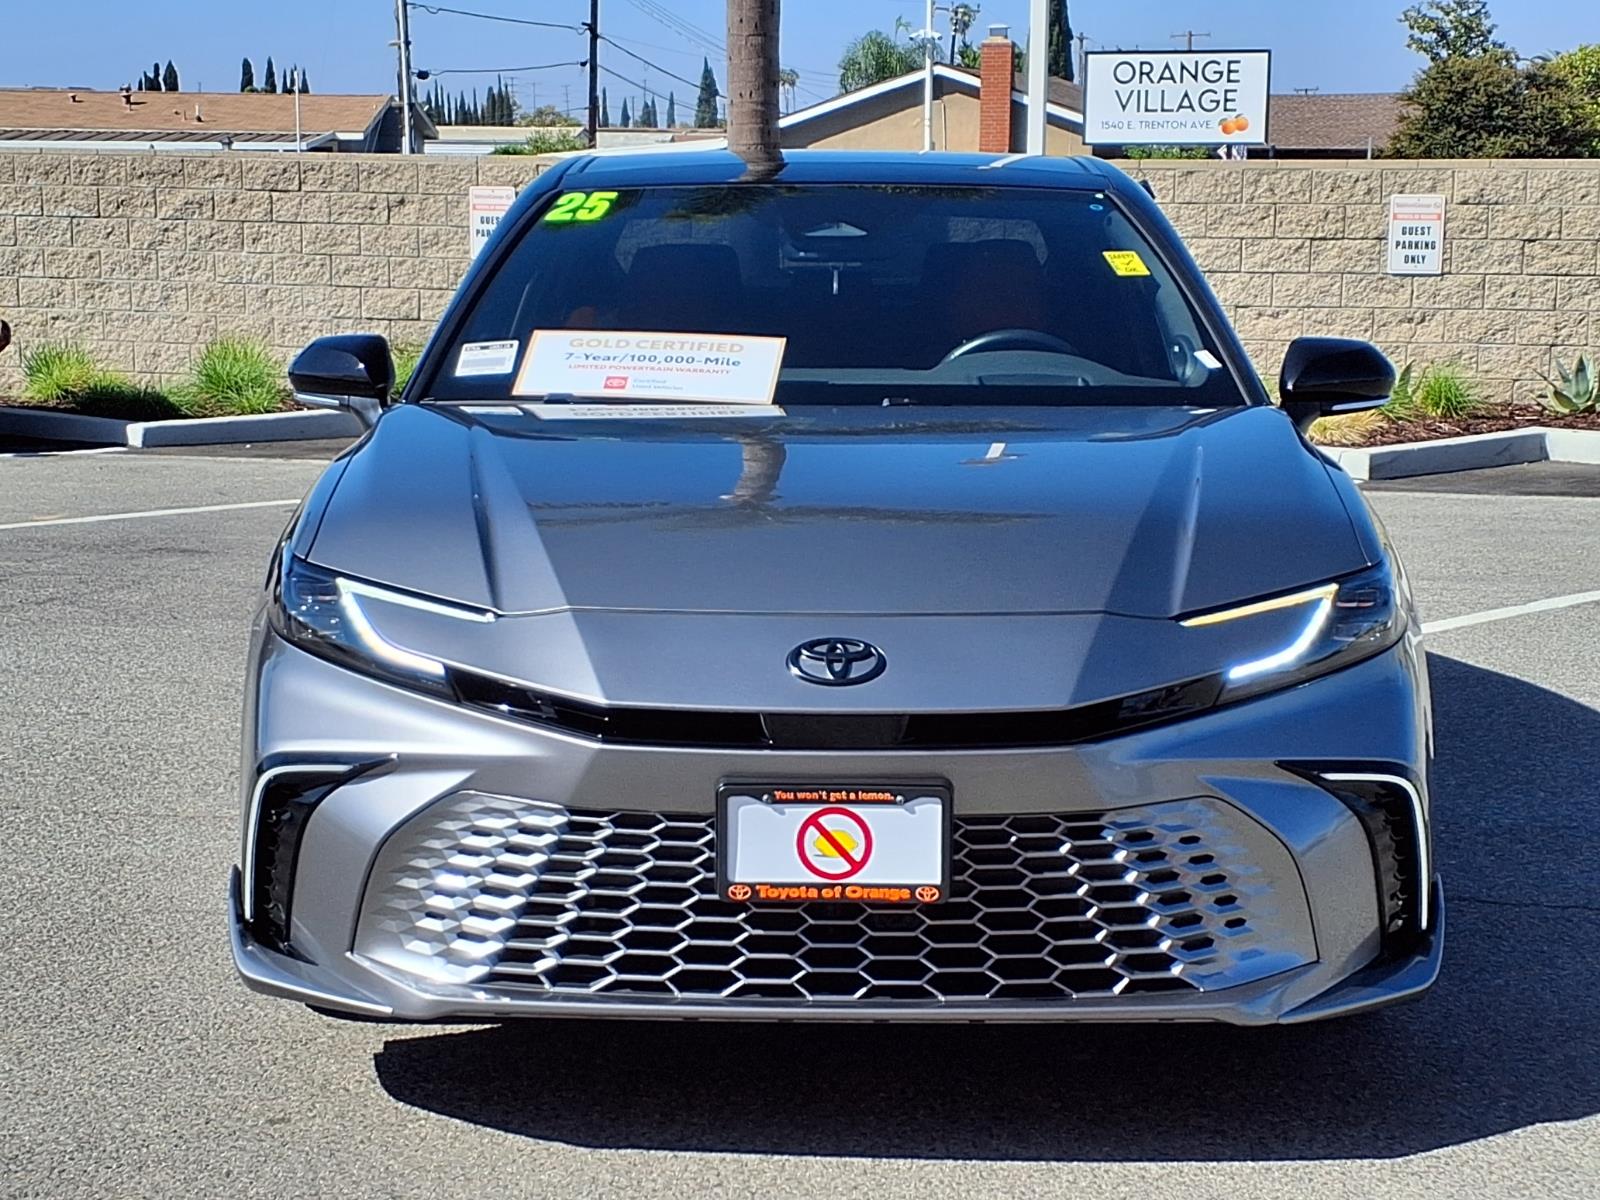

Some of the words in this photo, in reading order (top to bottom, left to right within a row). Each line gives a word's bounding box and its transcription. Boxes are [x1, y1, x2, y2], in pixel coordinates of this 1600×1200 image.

[1113, 59, 1241, 85] ORANGE
[1114, 88, 1238, 113] VILLAGE
[1101, 120, 1124, 130] 1540
[1127, 120, 1136, 130] E.
[1138, 120, 1188, 130] TRENTON
[1190, 120, 1213, 129] AVE.
[544, 191, 619, 222] 25
[480, 215, 504, 225] GUES
[1401, 226, 1432, 236] GUEST
[1395, 240, 1437, 250] PARKING
[1404, 254, 1427, 264] ONLY
[569, 338, 631, 349] GOLD
[635, 339, 744, 353] CERTIFIED
[564, 352, 742, 367] 7-Year/100,000-Mile
[675, 367, 732, 375] WARRANTY
[774, 790, 795, 800] You
[796, 790, 828, 800] won't
[849, 791, 857, 800] a
[858, 790, 895, 800] lemon.
[755, 885, 818, 900] Toyota
[821, 885, 842, 899] of
[845, 885, 912, 902] Orange
